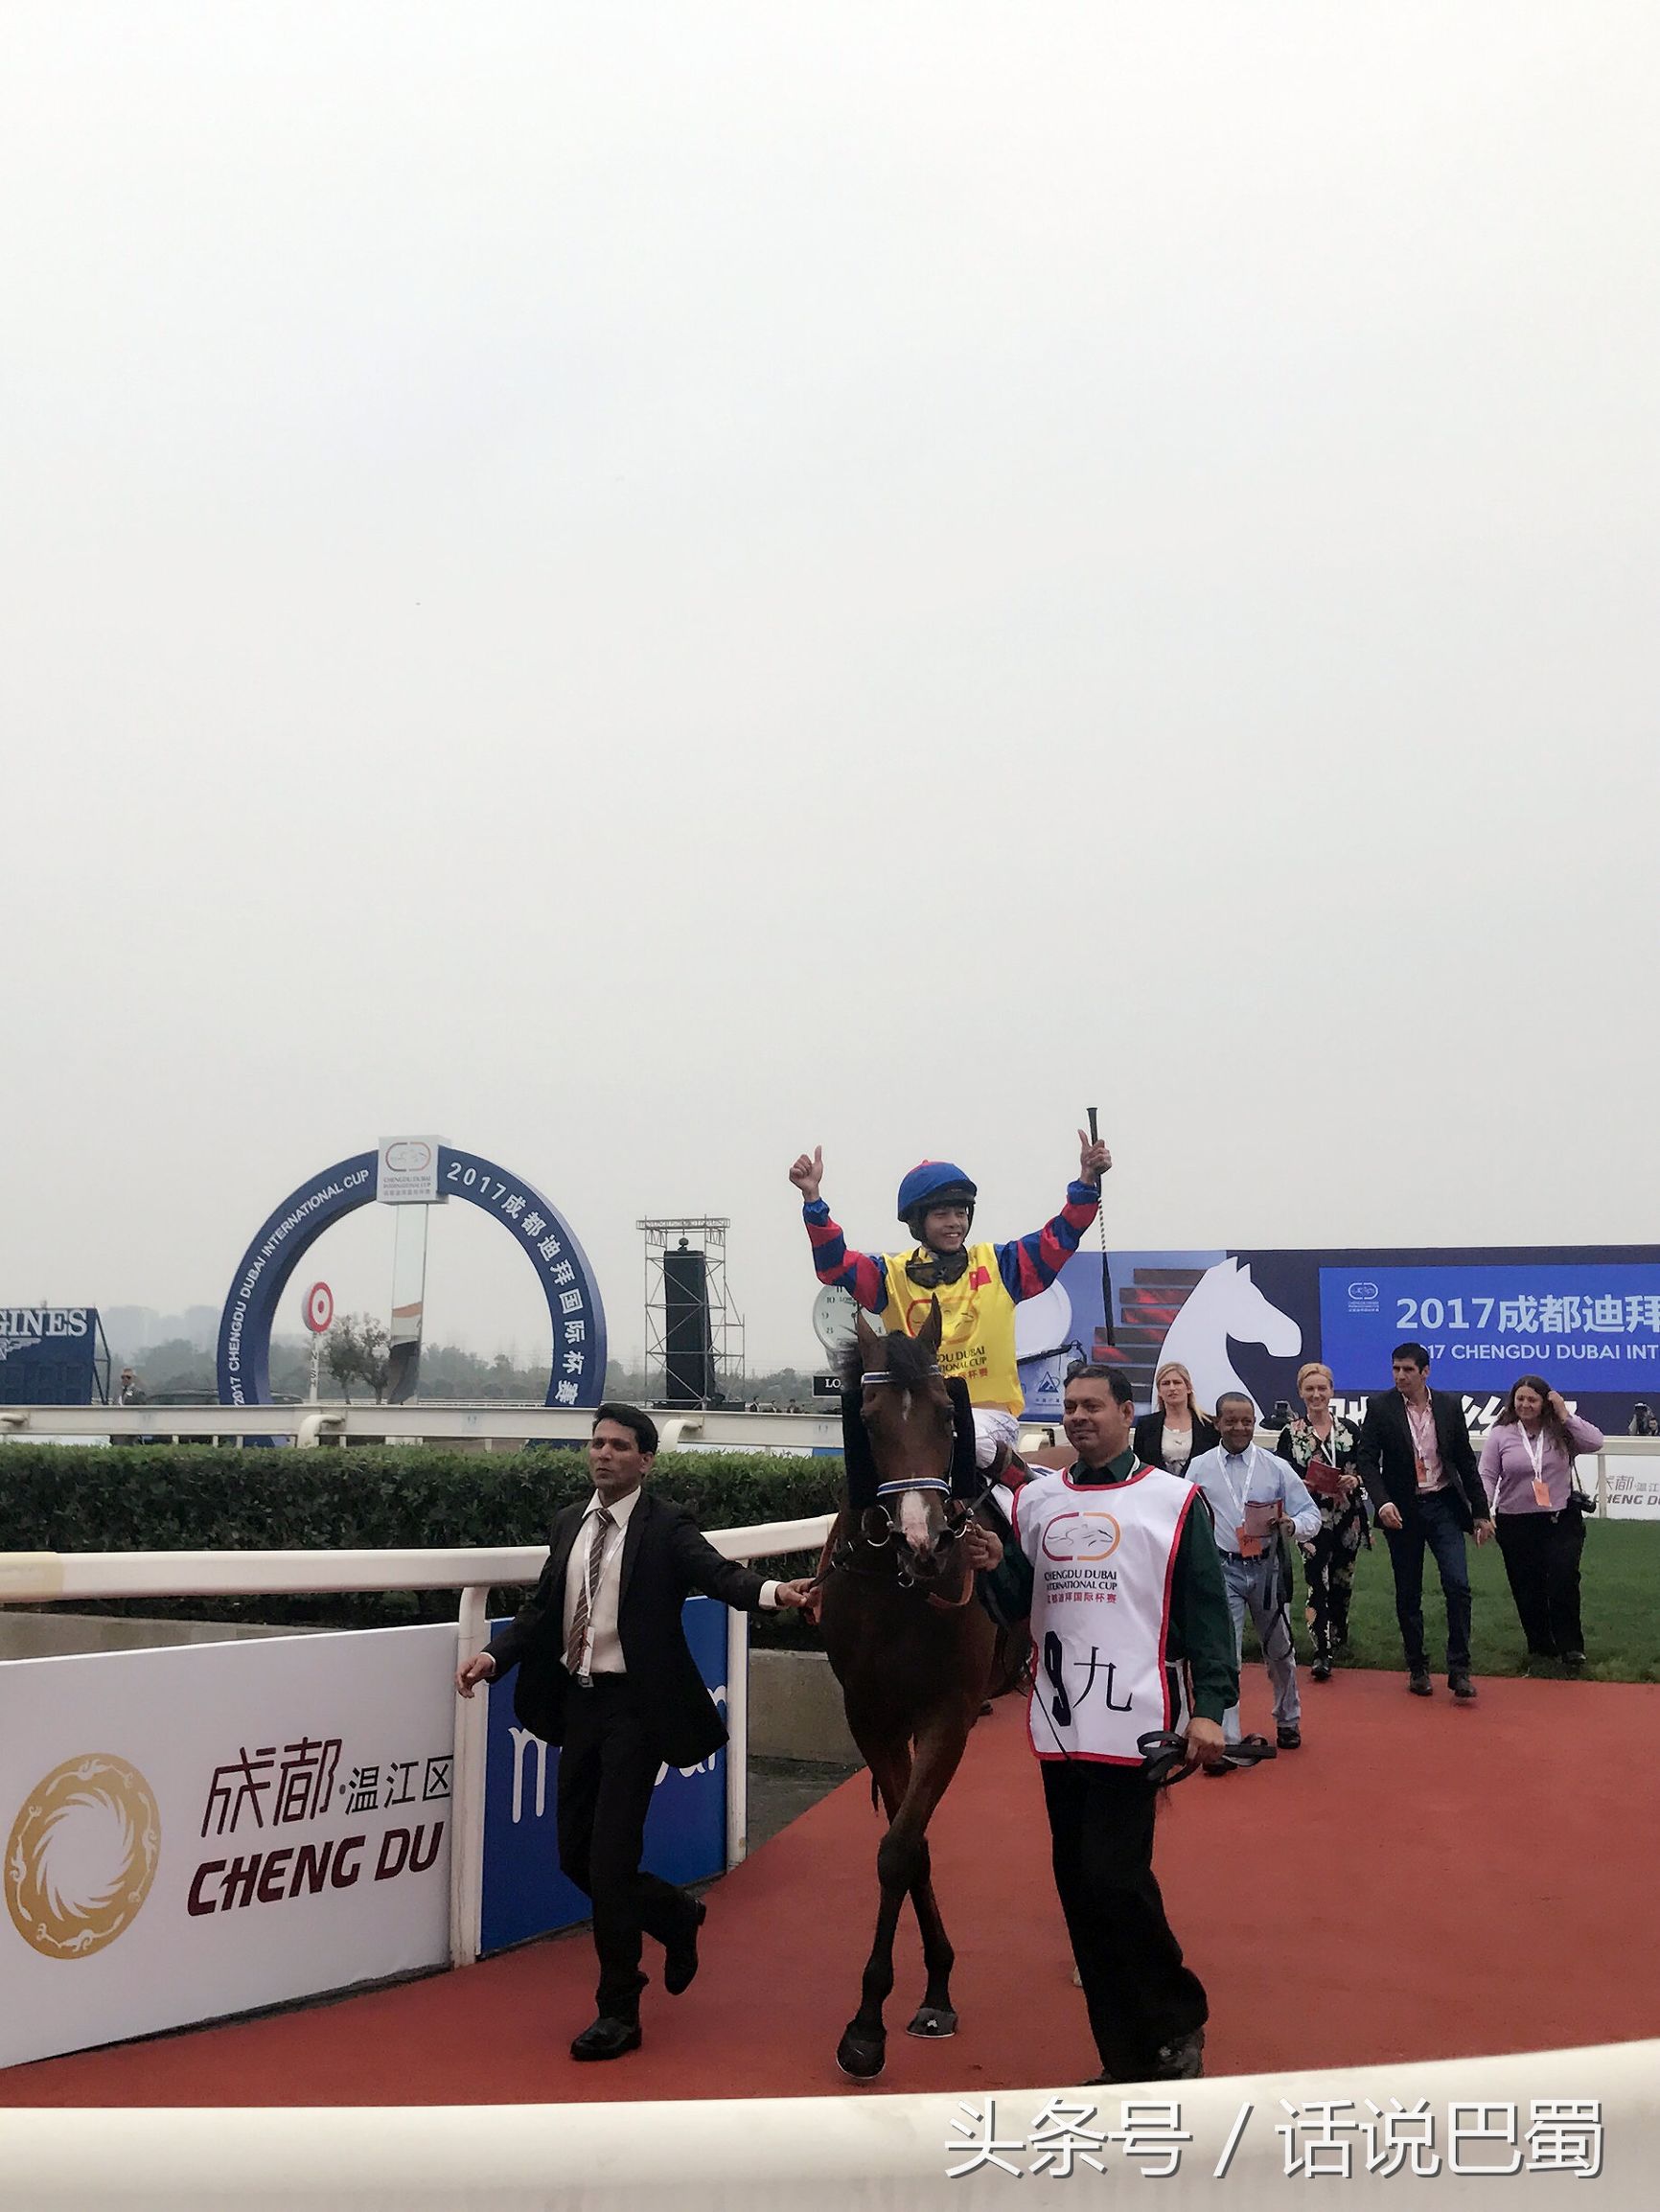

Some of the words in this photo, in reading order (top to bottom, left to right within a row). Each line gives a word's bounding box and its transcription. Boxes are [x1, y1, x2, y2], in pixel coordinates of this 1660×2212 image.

[228, 1302, 247, 1371] CHENGDU
[240, 1256, 266, 1299] DUBAI
[262, 1180, 344, 1258] INTERNATIONAL
[343, 1168, 370, 1188] CUP
[446, 1162, 586, 1406] 2017成都迪拜国际杯赛
[1395, 1294, 1660, 1334] 2017成都迪拜
[956, 1346, 985, 1361] DUBAI
[969, 1356, 987, 1368] CUP
[1420, 1344, 1446, 1360] 17
[1450, 1344, 1551, 1360] CHENGDU
[1556, 1344, 1621, 1360] DUBAI
[1626, 1344, 1659, 1360] INT
[1084, 1569, 1118, 1580] DUBAI
[1097, 1581, 1118, 1591] CUP
[1044, 1630, 1072, 1727] 9
[1072, 1646, 1133, 1712] 九
[187, 1833, 368, 1917] CHENG
[374, 1821, 445, 1882] DU
